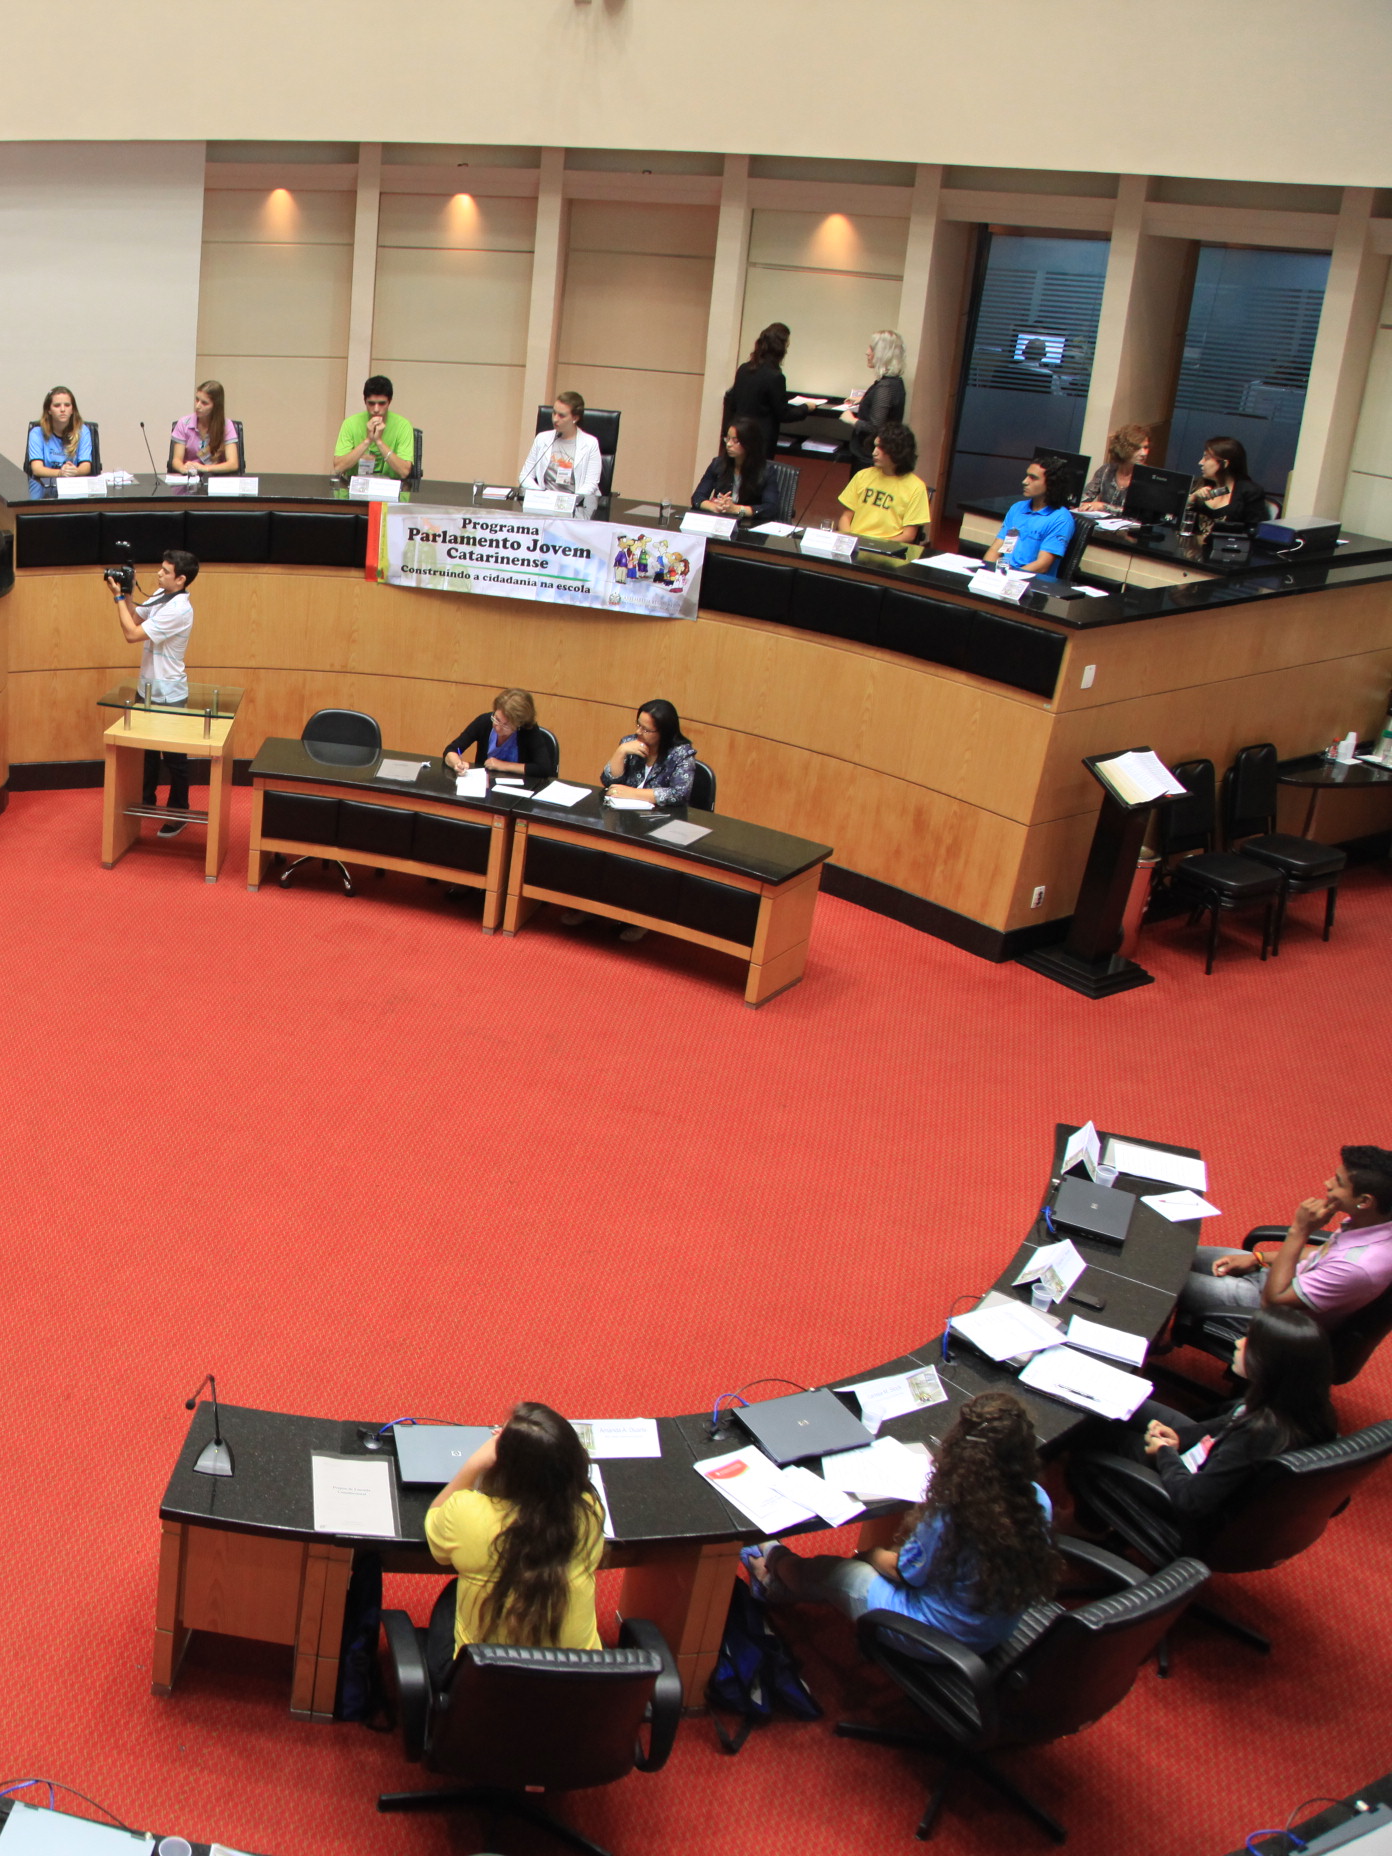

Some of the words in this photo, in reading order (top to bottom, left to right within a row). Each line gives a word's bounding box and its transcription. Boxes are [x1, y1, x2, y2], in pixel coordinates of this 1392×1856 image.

[862, 488, 894, 510] PEC
[462, 517, 539, 536] Programa
[408, 527, 522, 551] Parlamento
[526, 538, 592, 560] Jovem
[446, 546, 549, 570] Catarinense
[401, 564, 471, 580] Construindo
[473, 573, 480, 581] a
[482, 573, 538, 587] cidadania
[540, 580, 554, 589] na
[556, 582, 591, 594] escola
